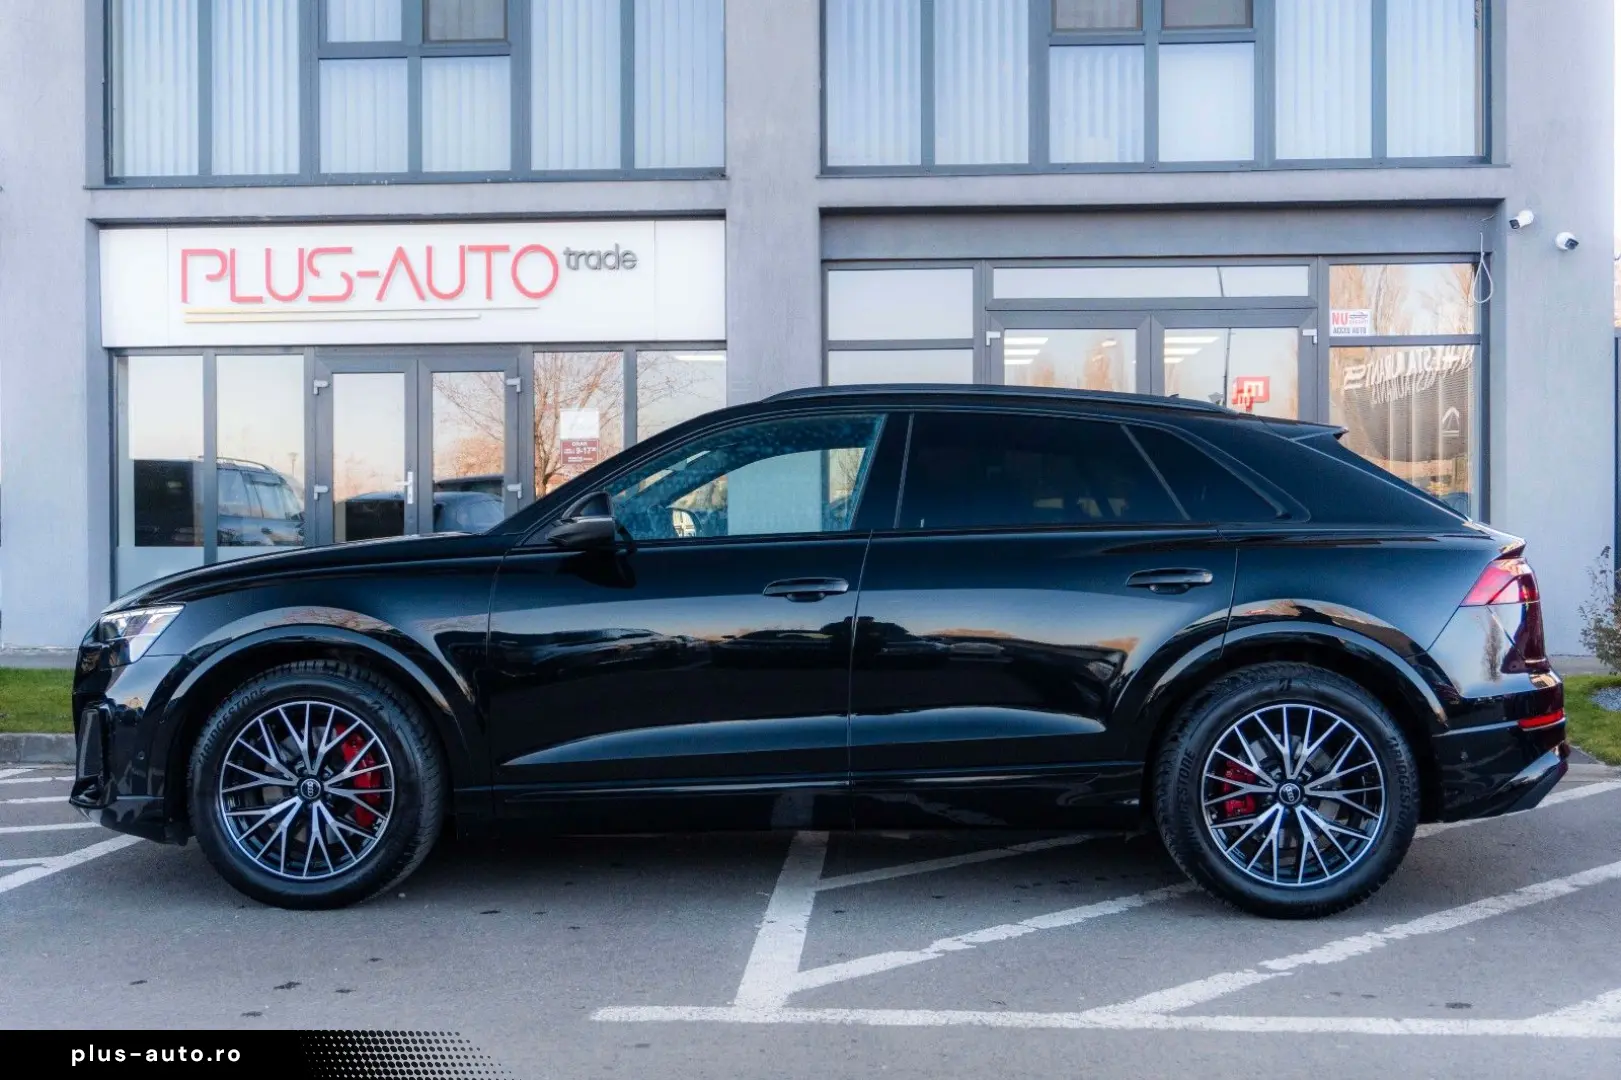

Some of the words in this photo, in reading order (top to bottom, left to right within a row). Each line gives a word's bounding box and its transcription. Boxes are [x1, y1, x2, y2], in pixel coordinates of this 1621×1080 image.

[181, 244, 559, 303] PLUS-AUTO
[563, 242, 638, 271] trade
[1332, 312, 1348, 325] NU
